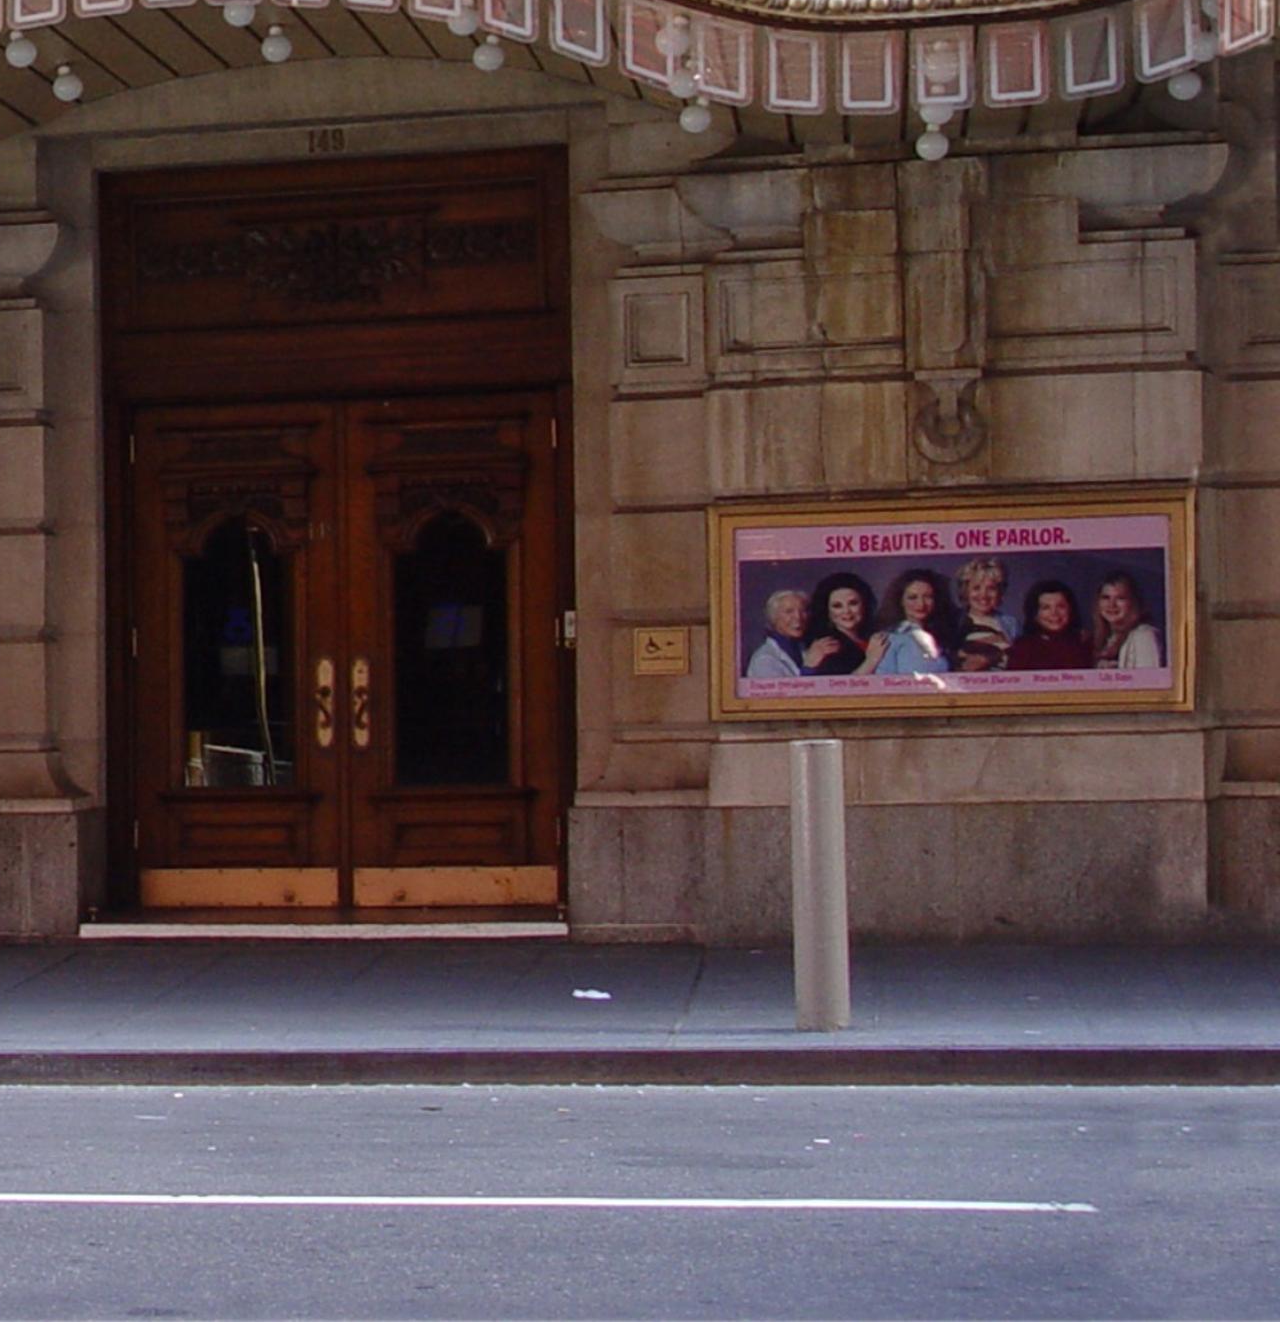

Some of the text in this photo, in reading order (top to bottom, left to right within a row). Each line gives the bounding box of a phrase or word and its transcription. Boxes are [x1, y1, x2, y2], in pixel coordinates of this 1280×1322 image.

[308, 127, 345, 153] 149
[825, 527, 1071, 554] SIX BEAUTIES. ONE PARLOR.
